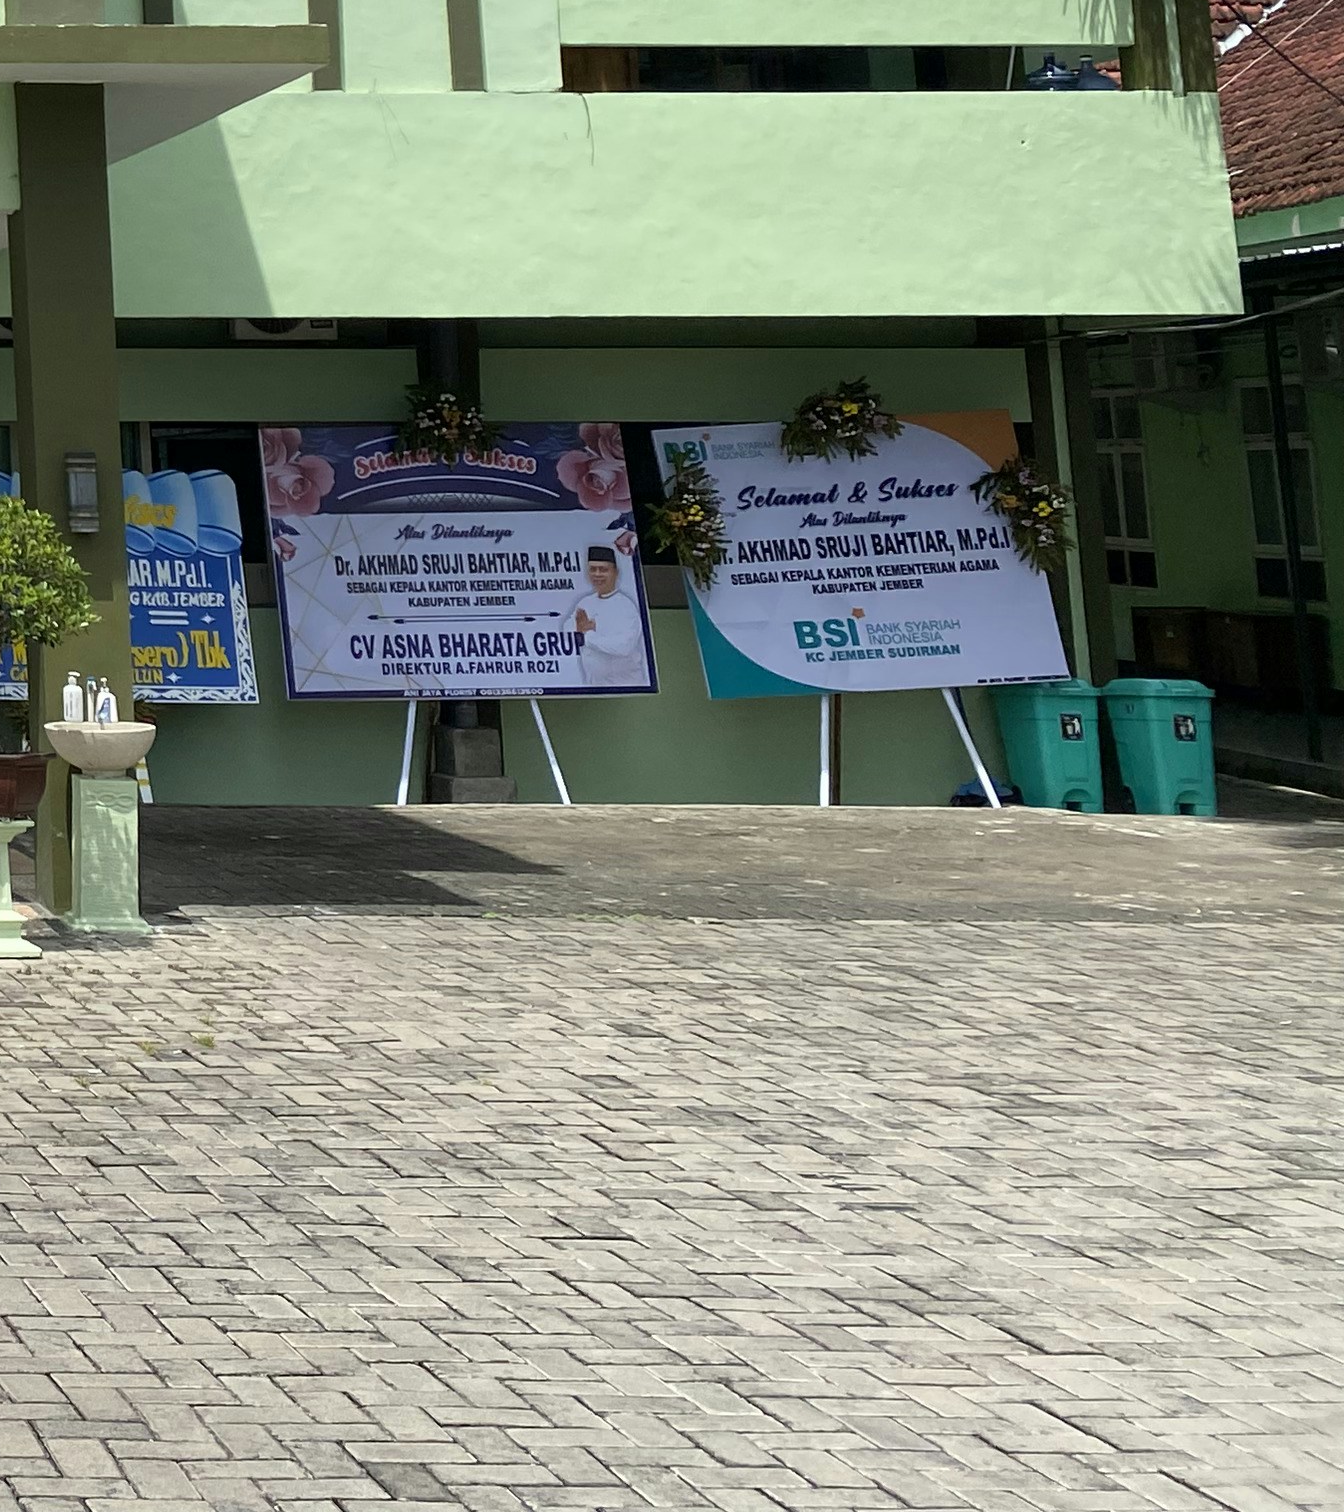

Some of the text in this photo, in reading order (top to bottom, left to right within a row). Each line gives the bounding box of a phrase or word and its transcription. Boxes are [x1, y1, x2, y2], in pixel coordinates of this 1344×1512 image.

[736, 477, 960, 510] Selamat & Sukses
[738, 537, 812, 564] AKHMAD
[815, 534, 868, 560] SRUJI
[870, 529, 956, 557] BAHTIAR,
[956, 526, 1011, 551] M.Pd.I
[334, 551, 582, 578] Dr. AKHMAD SRUJI BAHTIAR, M.Pd.I
[730, 558, 1000, 586] SEBAGAI KEPALA KANTOR KEMENTERIAN AGAMA
[346, 578, 575, 594] SEBAGAI KEPALA KANTOR KEMENTERIAN AGAMA
[812, 578, 925, 595] KABUPATEN JEMBER
[408, 595, 517, 608] KABUPATEN JEMBER
[792, 617, 861, 650] BSI
[865, 619, 962, 635] BANK SYARIAH
[350, 631, 586, 660] CV ASNA BHARATA GRUP
[868, 631, 945, 645] INDONESIA
[805, 644, 962, 663] KC JEMBER SUDIRMAN
[381, 660, 561, 676] DIREKTUR A.FAHRUR ROZI
